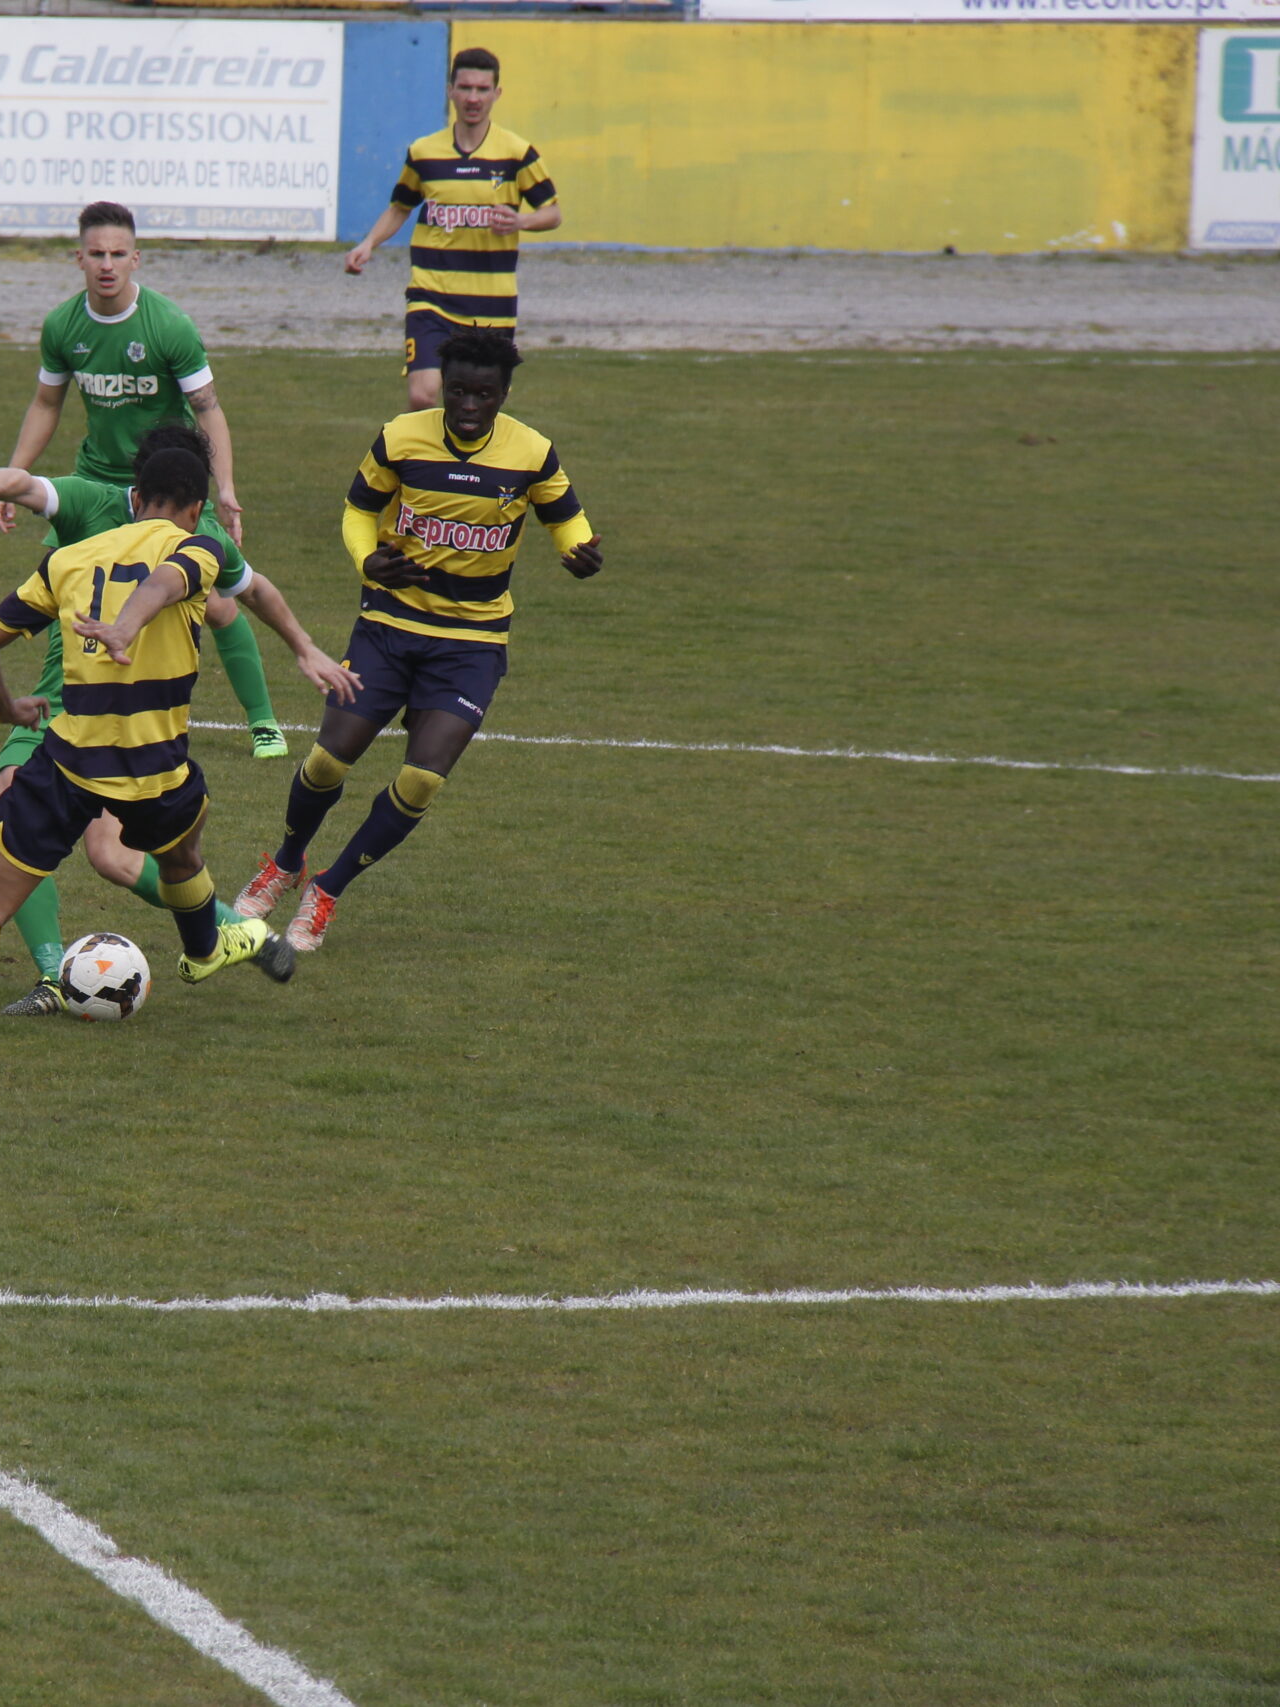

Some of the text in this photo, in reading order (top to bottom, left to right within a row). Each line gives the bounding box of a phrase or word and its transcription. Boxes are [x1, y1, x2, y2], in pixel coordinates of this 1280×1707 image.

[20, 43, 326, 88] Caldeireiro
[65, 108, 315, 144] PROFISSIONAL
[21, 157, 37, 186] O
[42, 158, 85, 186] TIPO
[90, 158, 117, 187] DE
[122, 159, 189, 188] ROUPA
[195, 160, 221, 188] DE
[226, 160, 330, 190] TRABALHO
[196, 208, 316, 231] BRAGANÇA
[424, 198, 494, 233] Fepron
[72, 370, 137, 397] PROZIS
[448, 472, 480, 483] macron
[397, 503, 513, 552] Fepronor
